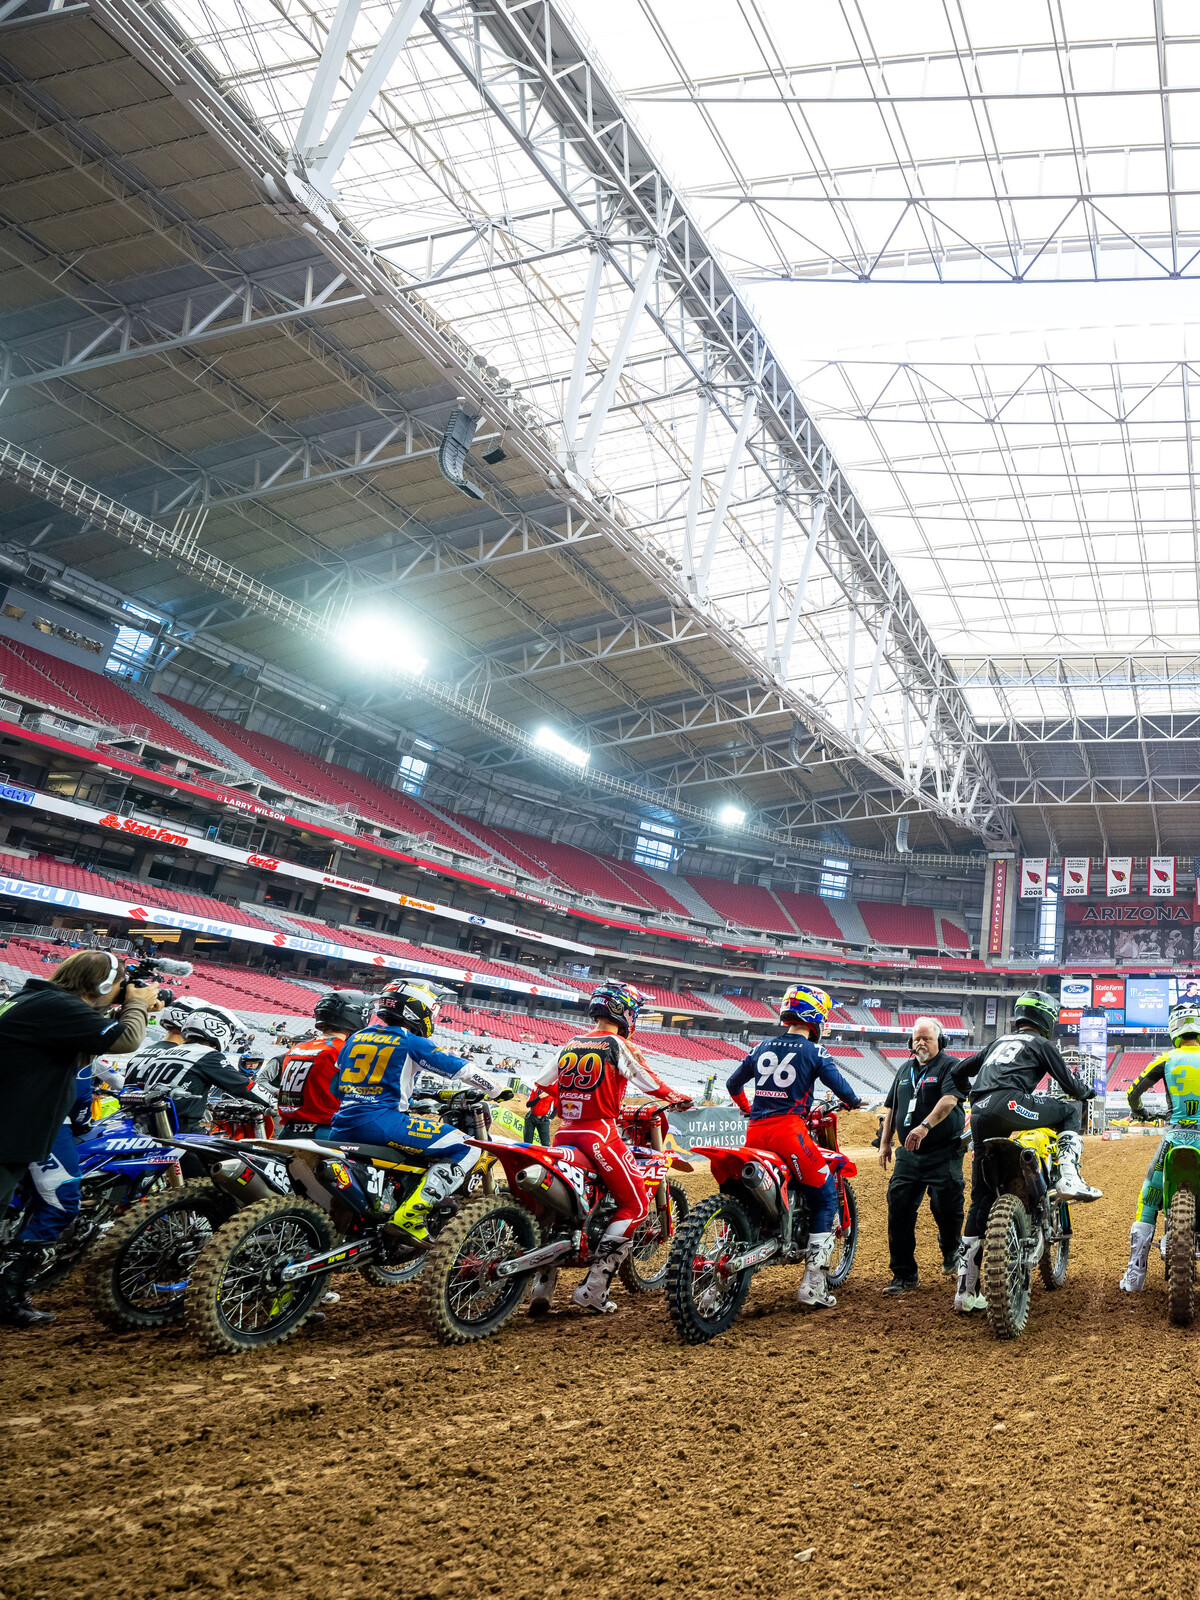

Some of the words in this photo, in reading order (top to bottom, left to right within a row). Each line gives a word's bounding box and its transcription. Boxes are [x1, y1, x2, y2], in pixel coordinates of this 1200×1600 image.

[223, 797, 252, 811] LARRY
[254, 806, 287, 822] WILSON
[1083, 906, 1190, 921] ARIZONA
[352, 1033, 401, 1045] SWOLL
[280, 1060, 314, 1092] 432
[341, 1044, 395, 1085] 31
[558, 1052, 603, 1090] 29
[757, 1051, 797, 1088] 96
[755, 1090, 788, 1098] HONDA
[1014, 1105, 1039, 1120] SUZUKI
[293, 1123, 318, 1133] FLY
[689, 1121, 717, 1133] UTAH
[719, 1120, 749, 1132] SPORT
[689, 1135, 746, 1148] COMMISSIO
[592, 1142, 613, 1172] GASGAS
[367, 1166, 385, 1197] 31
[558, 1160, 585, 1195] 29
